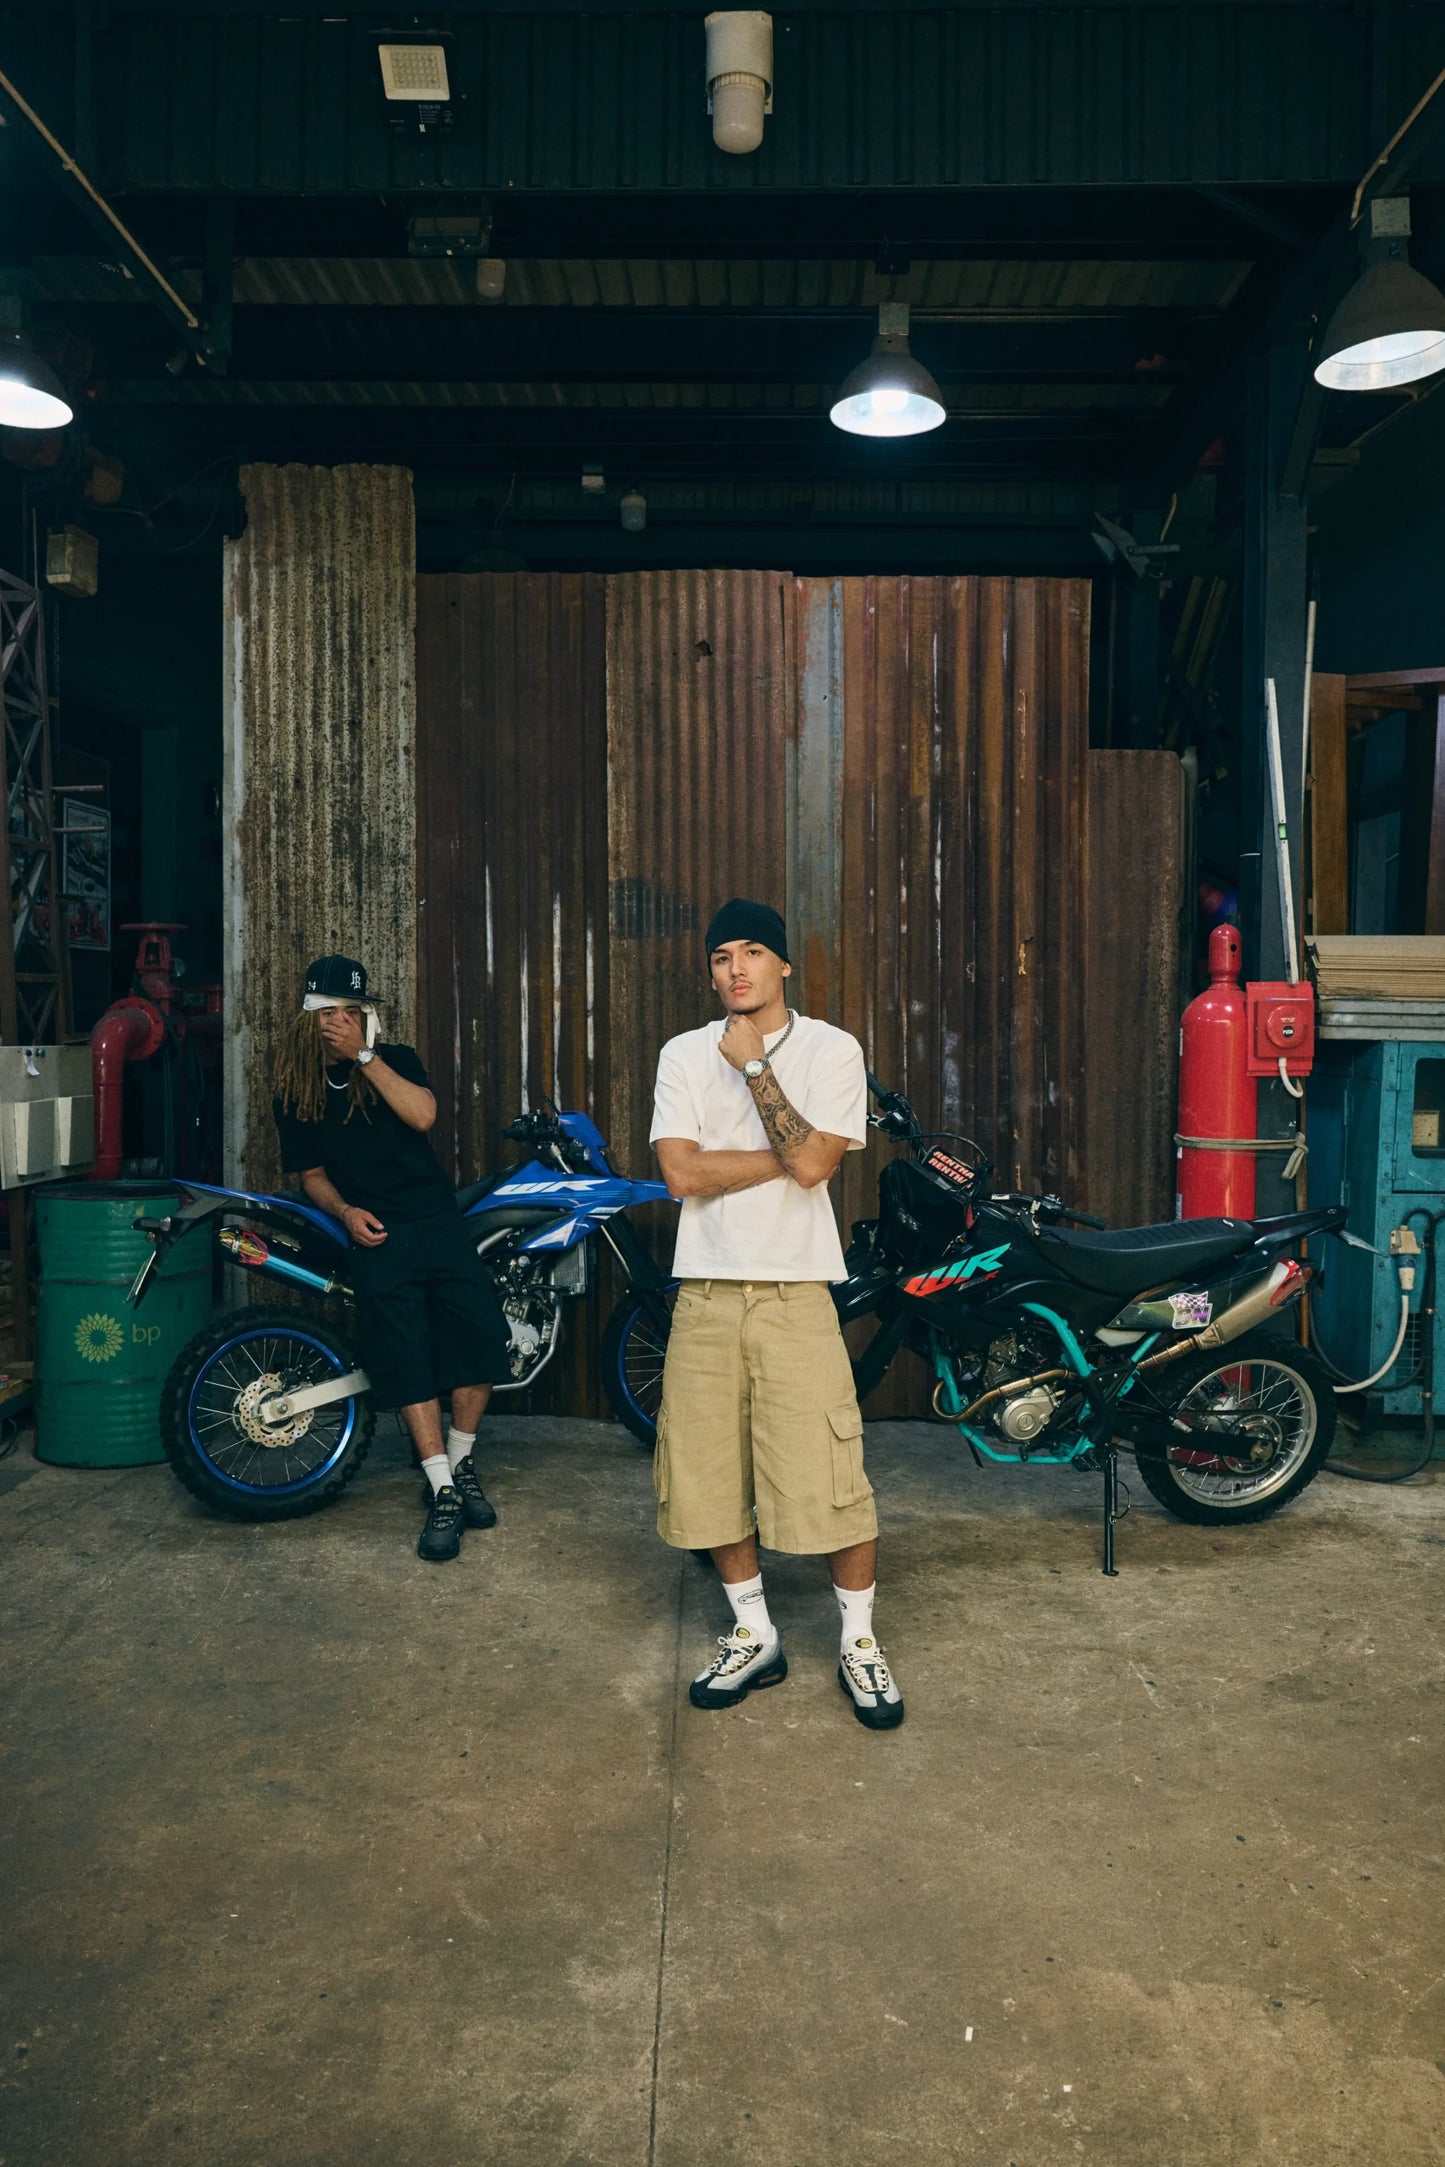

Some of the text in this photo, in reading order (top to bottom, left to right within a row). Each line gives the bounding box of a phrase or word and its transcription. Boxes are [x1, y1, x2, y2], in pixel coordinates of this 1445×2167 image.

[932, 1151, 975, 1179] RENTHA
[493, 1179, 610, 1196] WR
[903, 1242, 1011, 1297] WR
[132, 1323, 161, 1346] bp
